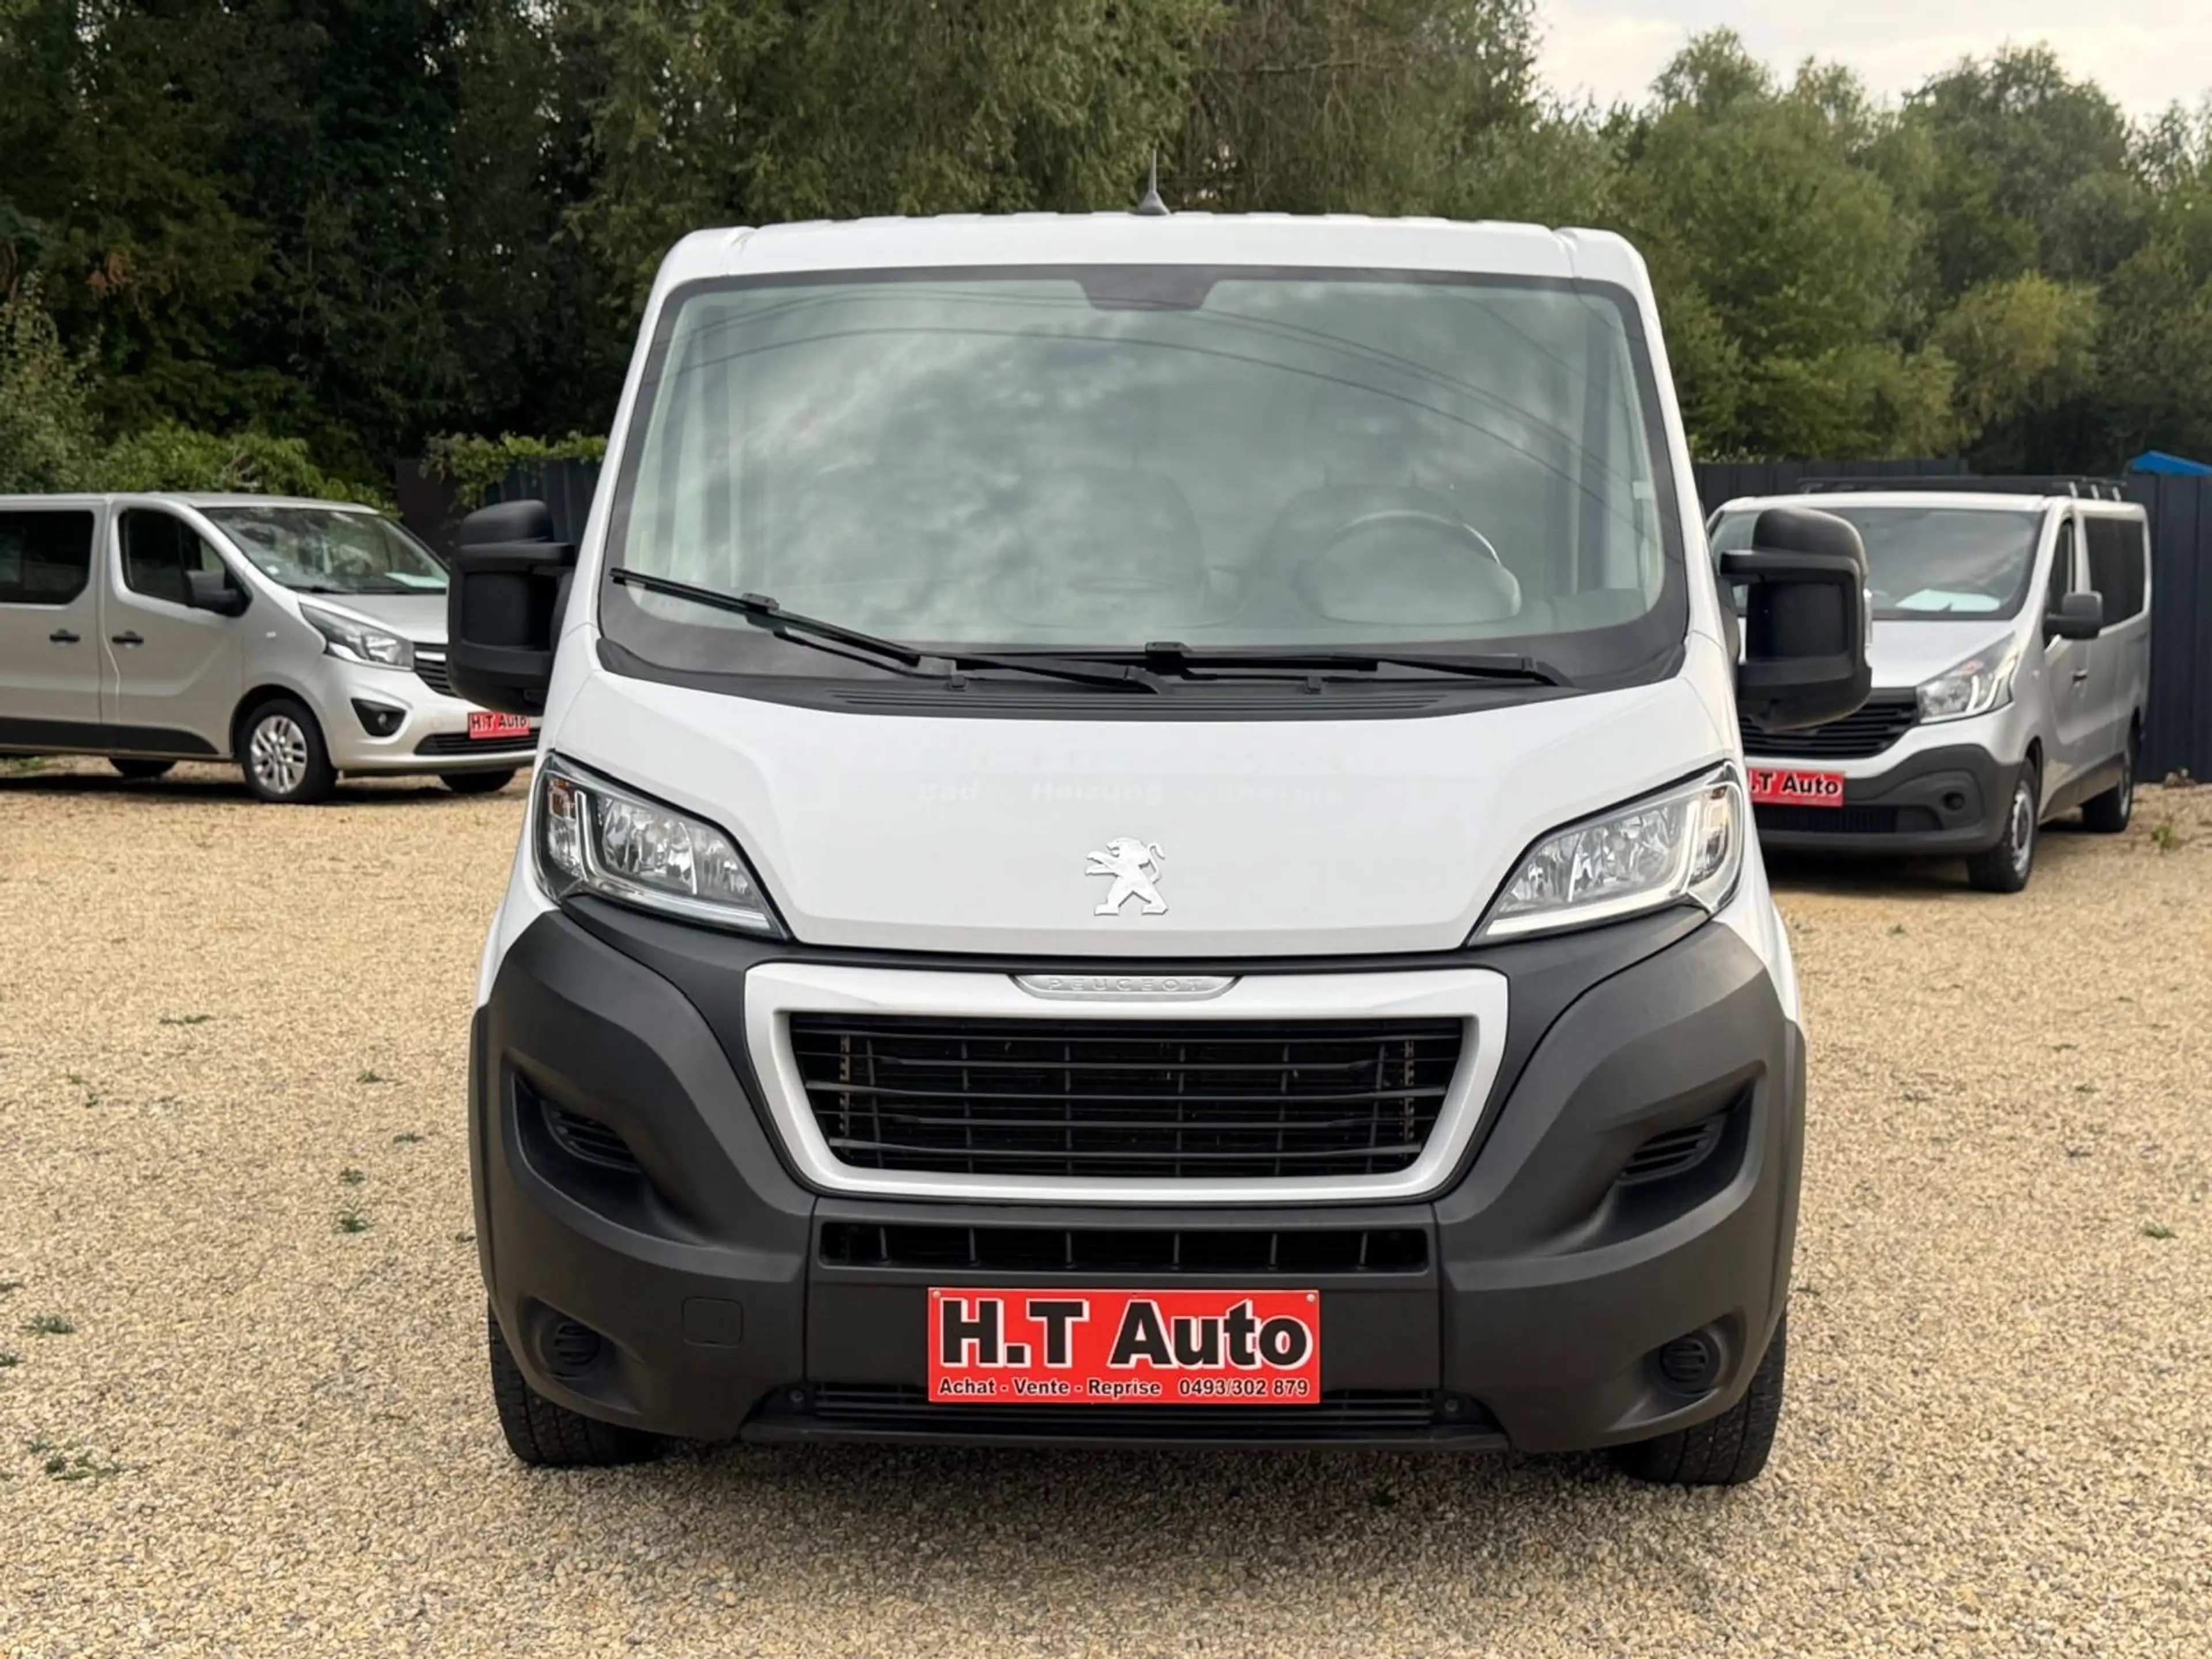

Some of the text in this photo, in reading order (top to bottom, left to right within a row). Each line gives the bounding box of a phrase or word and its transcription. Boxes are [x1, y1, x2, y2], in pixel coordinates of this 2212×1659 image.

[1749, 771, 1842, 797] .T Auto
[1048, 978, 1203, 991] PEUGEOT
[940, 1298, 1313, 1370] H.T Auto
[938, 1378, 996, 1396] Achat
[1014, 1378, 1069, 1396] Vente
[1087, 1378, 1161, 1399] Reprise
[1178, 1378, 1266, 1396] 0493/302
[1273, 1378, 1309, 1396] 879
